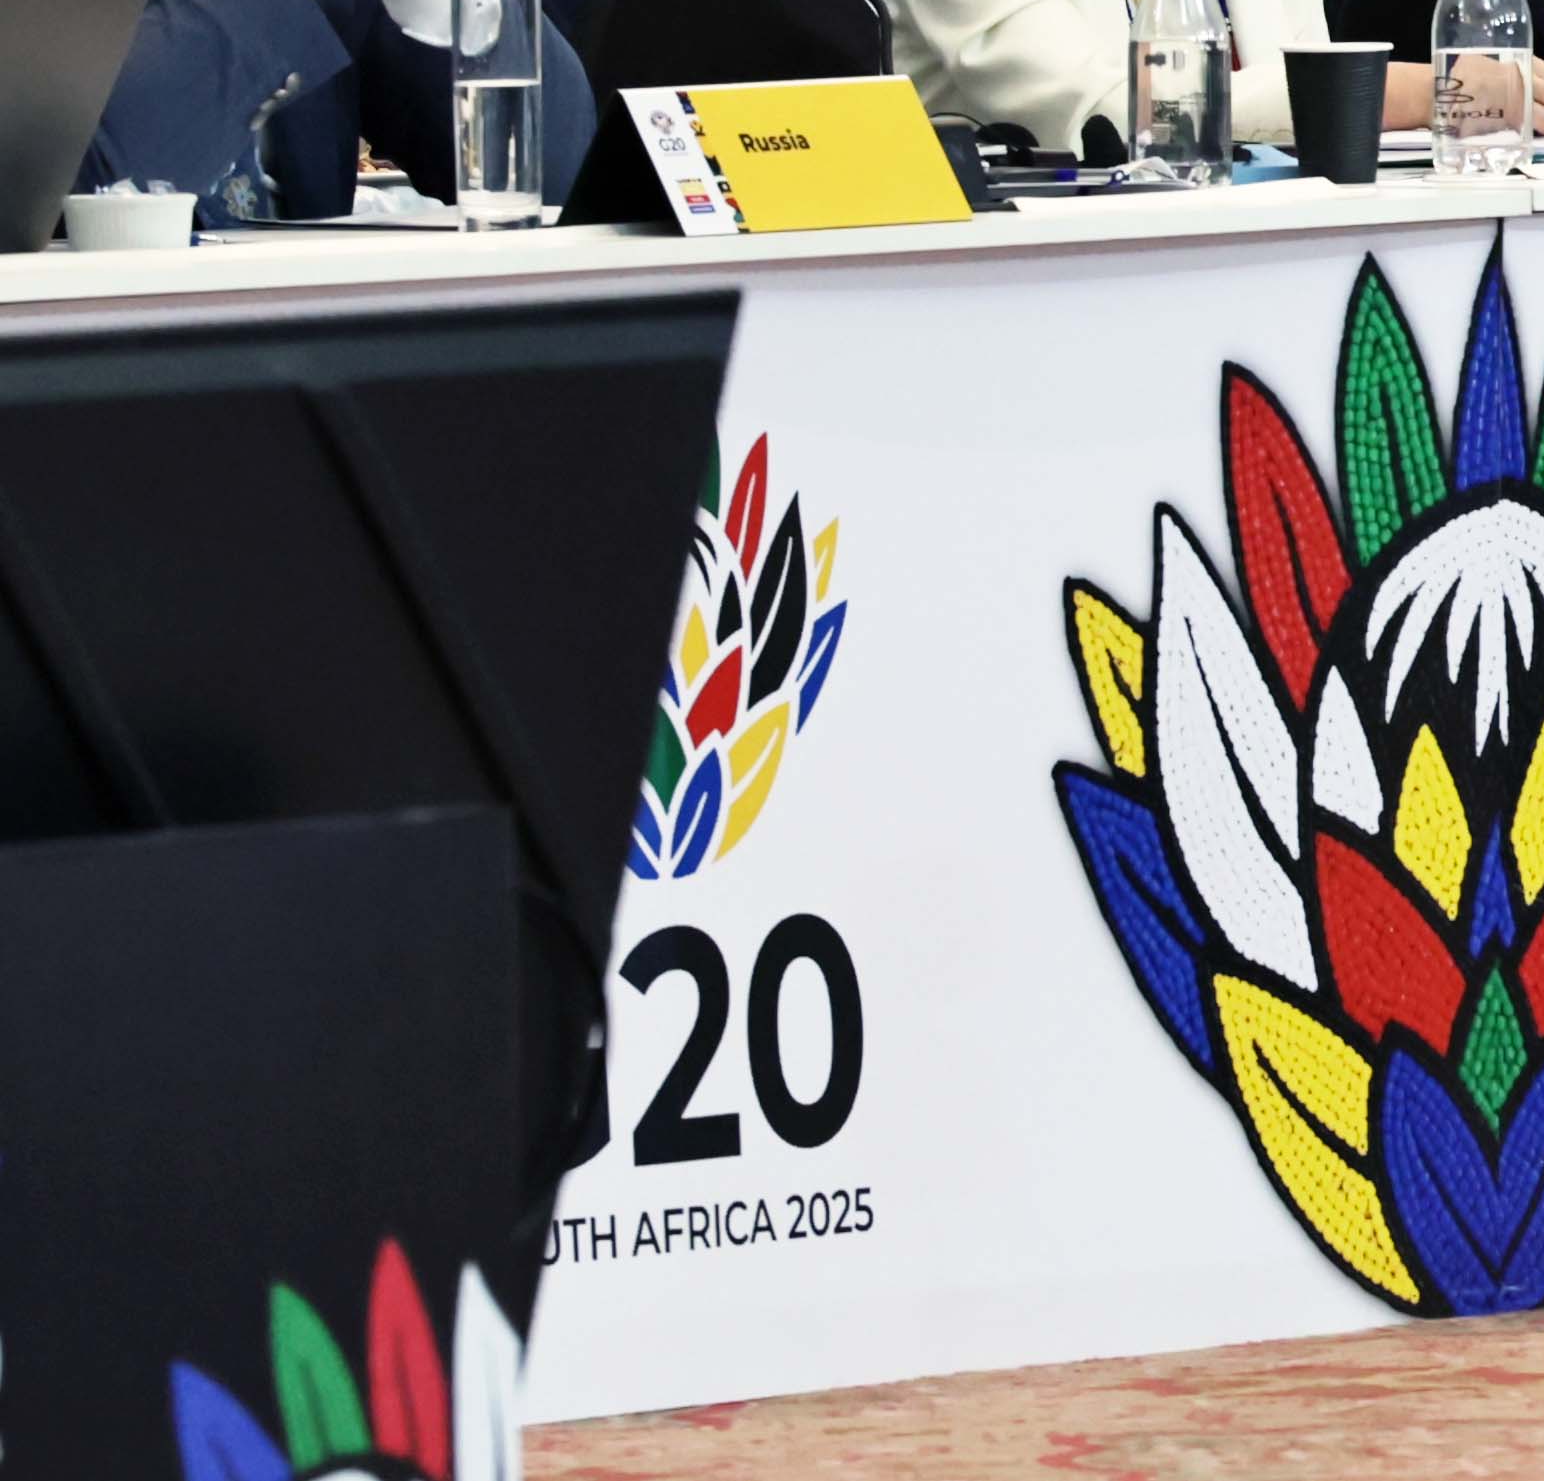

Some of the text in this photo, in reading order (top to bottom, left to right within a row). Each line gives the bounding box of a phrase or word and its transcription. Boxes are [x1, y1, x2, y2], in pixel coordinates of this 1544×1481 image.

[738, 128, 811, 153] Russia
[566, 912, 864, 1172] 20
[632, 1198, 777, 1258] AFRICA
[786, 1186, 875, 1240] 2025
